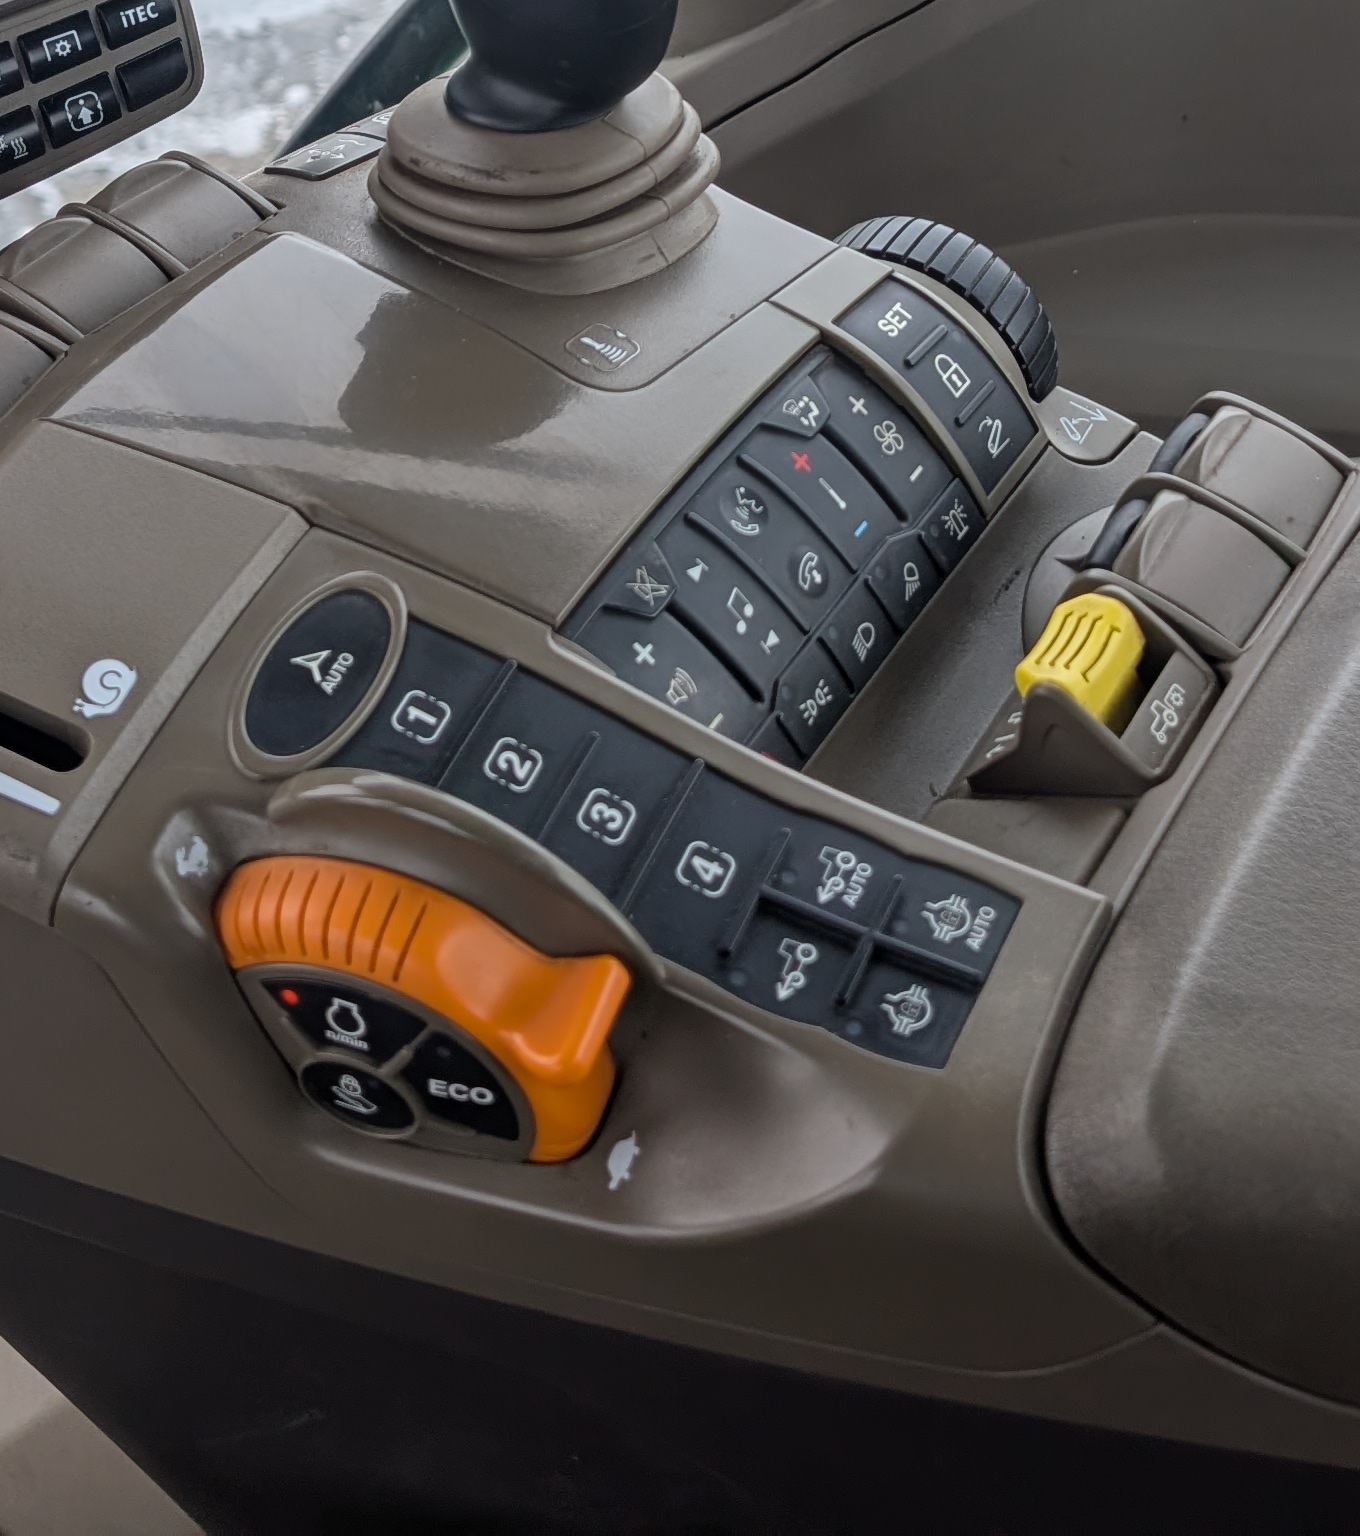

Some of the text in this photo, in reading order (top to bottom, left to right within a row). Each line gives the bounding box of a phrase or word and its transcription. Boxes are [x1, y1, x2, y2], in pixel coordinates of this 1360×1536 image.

[118, 0, 160, 29] iTEC
[877, 302, 913, 337] SET
[320, 651, 354, 696] AUTO
[407, 705, 437, 726] 1
[497, 750, 533, 782] 2
[590, 802, 623, 832] 3
[692, 856, 725, 884] 4
[841, 862, 873, 908] AUTO
[966, 905, 998, 951] AUTO
[427, 1078, 494, 1105] ECO
